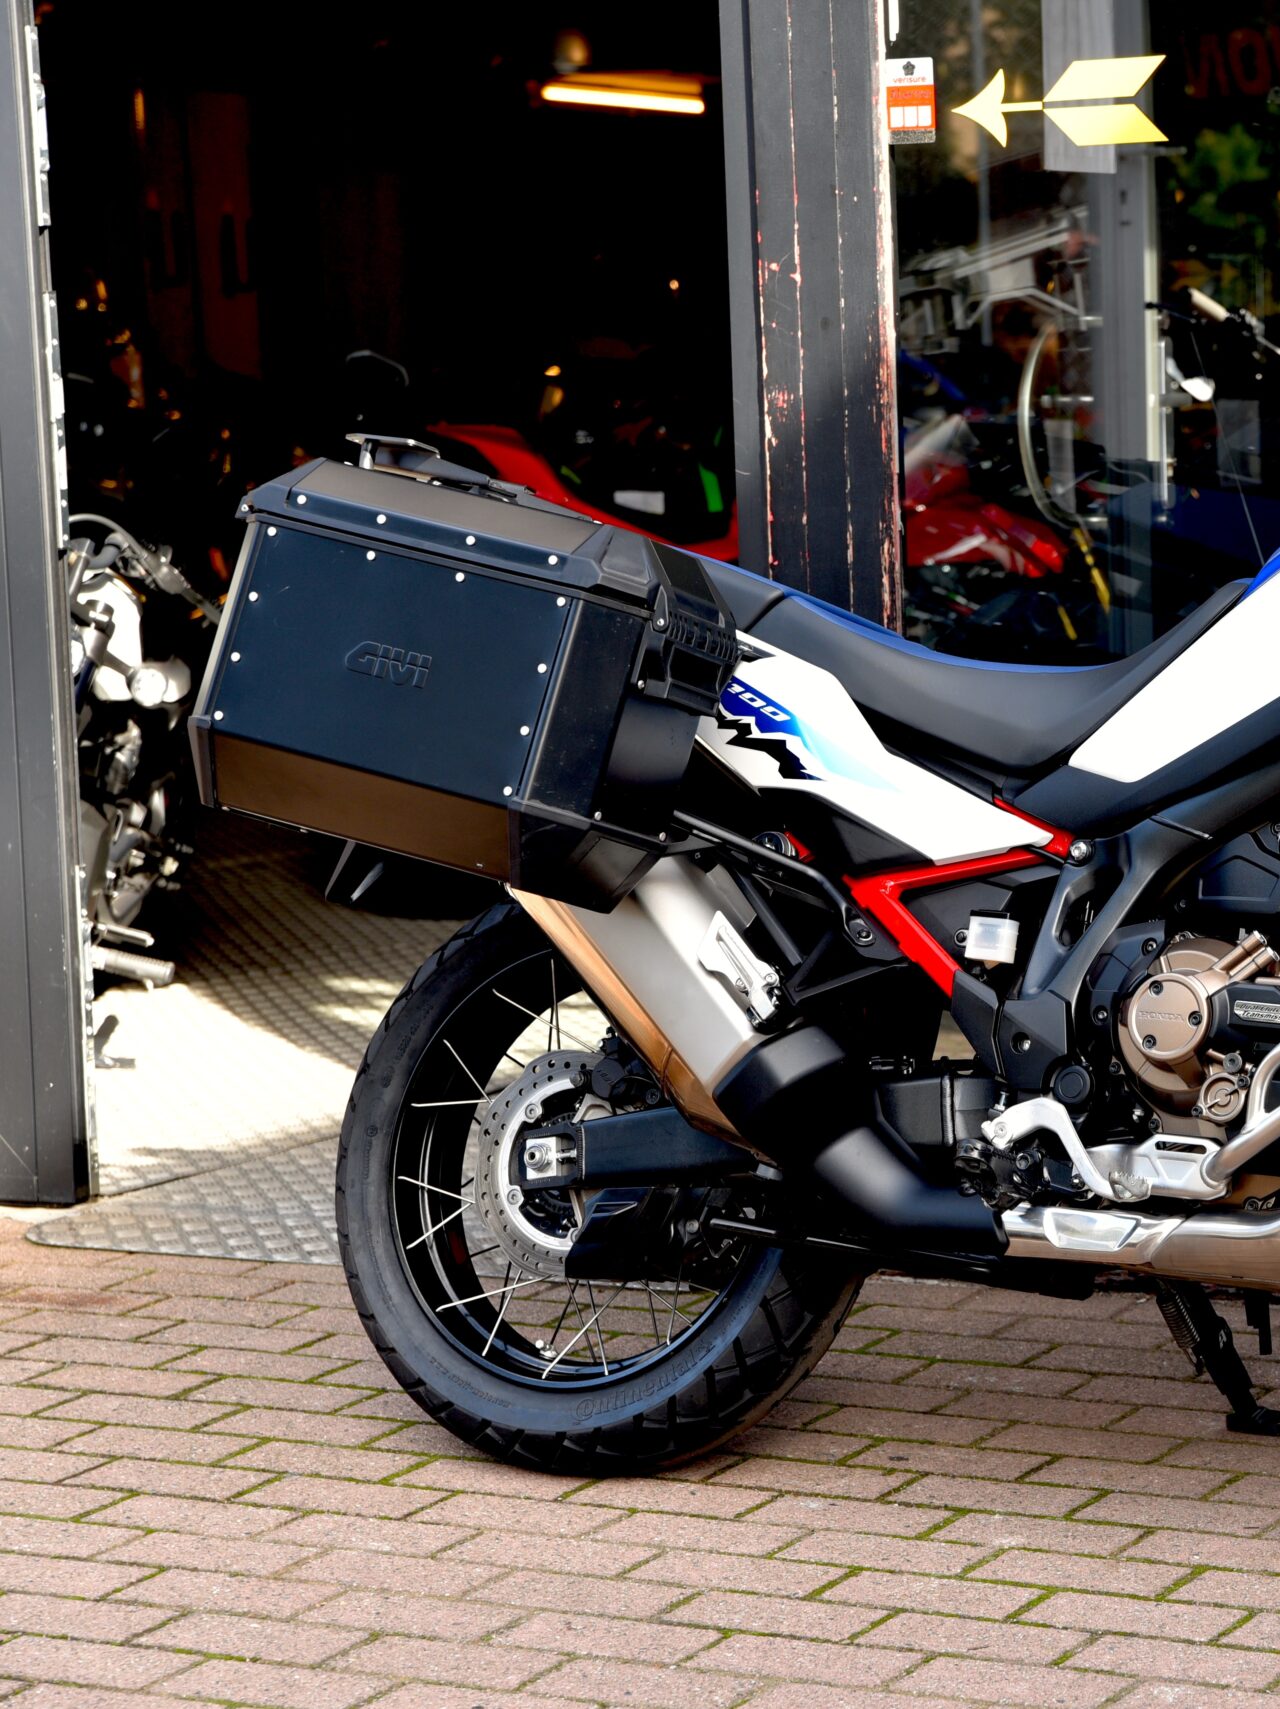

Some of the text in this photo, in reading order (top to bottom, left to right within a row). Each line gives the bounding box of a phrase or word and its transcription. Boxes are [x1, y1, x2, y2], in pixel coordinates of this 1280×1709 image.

[344, 640, 433, 690] GIVI
[1136, 1010, 1185, 1022] HONDA
[574, 1351, 699, 1422] Continental
